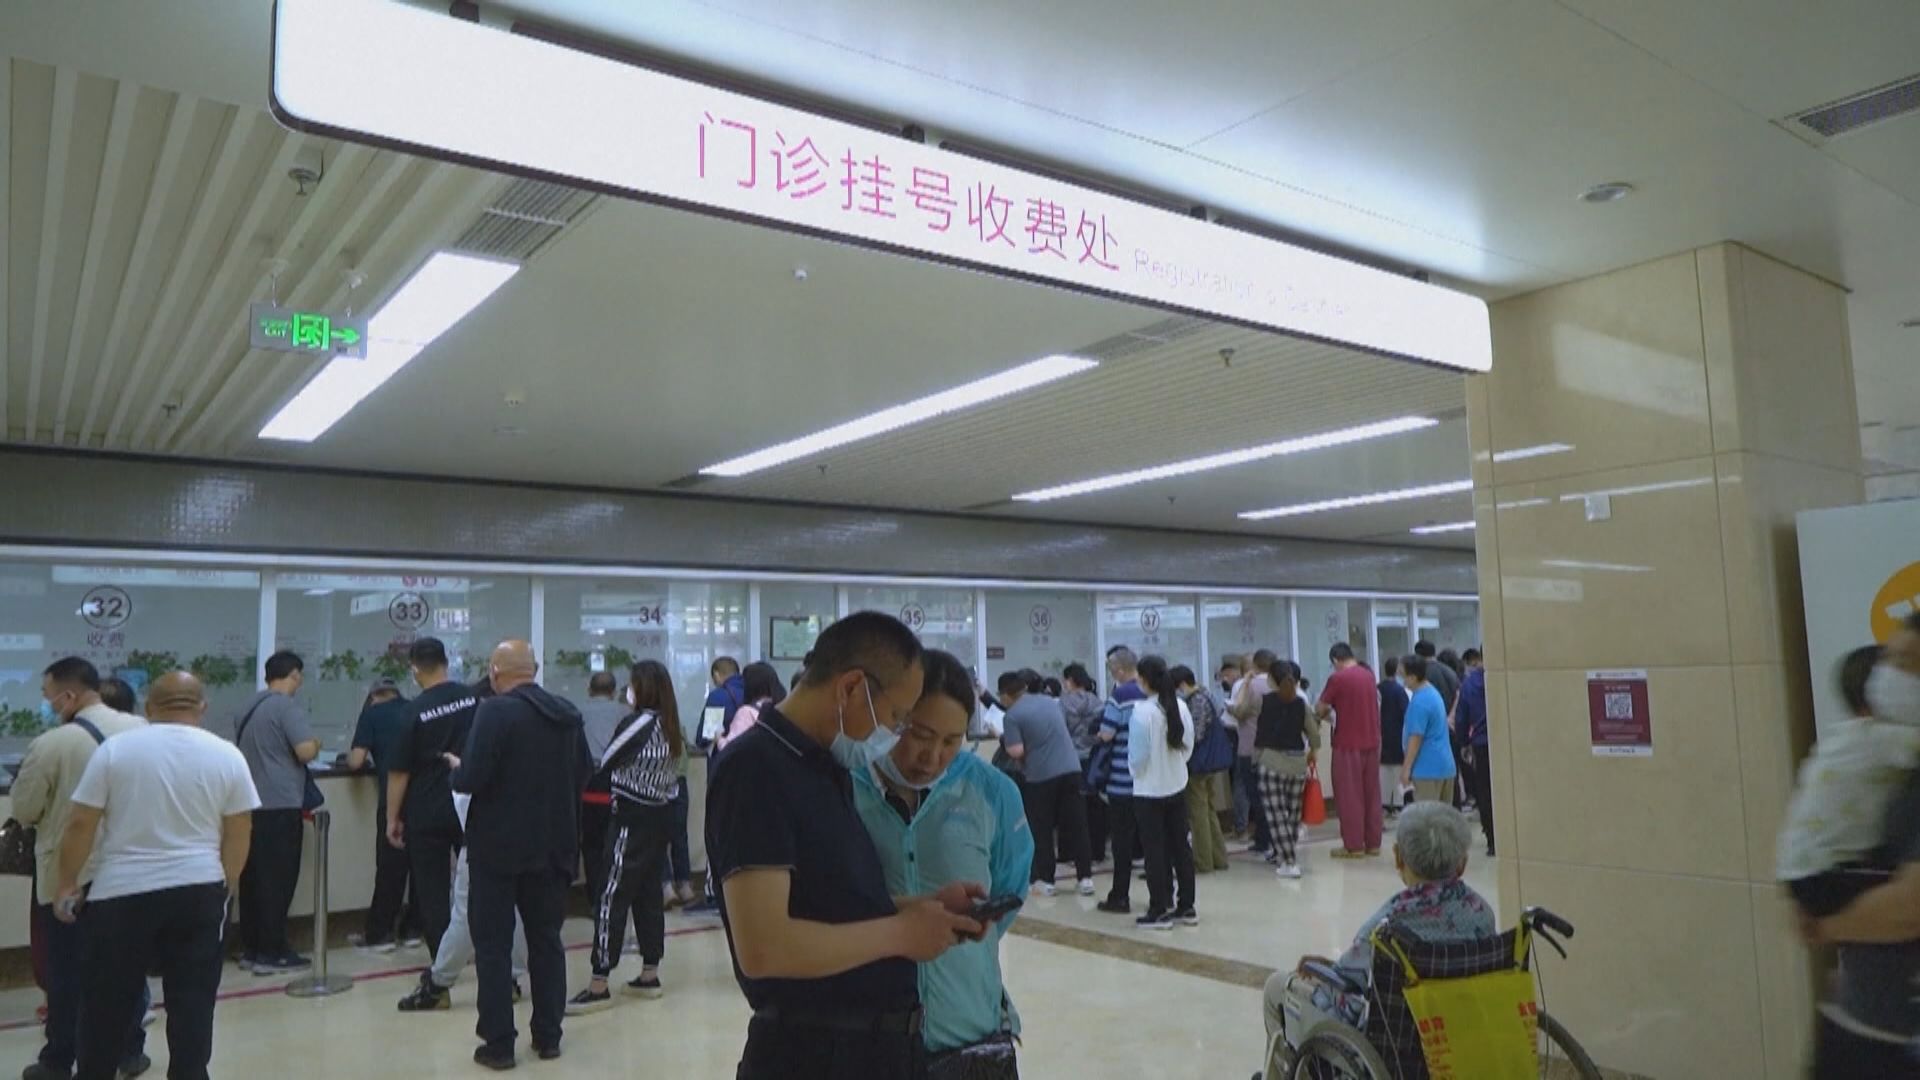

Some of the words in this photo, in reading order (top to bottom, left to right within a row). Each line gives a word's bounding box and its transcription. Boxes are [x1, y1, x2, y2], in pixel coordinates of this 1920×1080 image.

[699, 111, 1120, 271] 门诊挂号收费处
[89, 596, 123, 618] 32
[395, 601, 422, 622] 33
[639, 606, 662, 625] 34
[904, 609, 921, 626] 35
[1033, 611, 1049, 627] 36
[1144, 613, 1157, 627] 37
[86, 631, 125, 648] 收费
